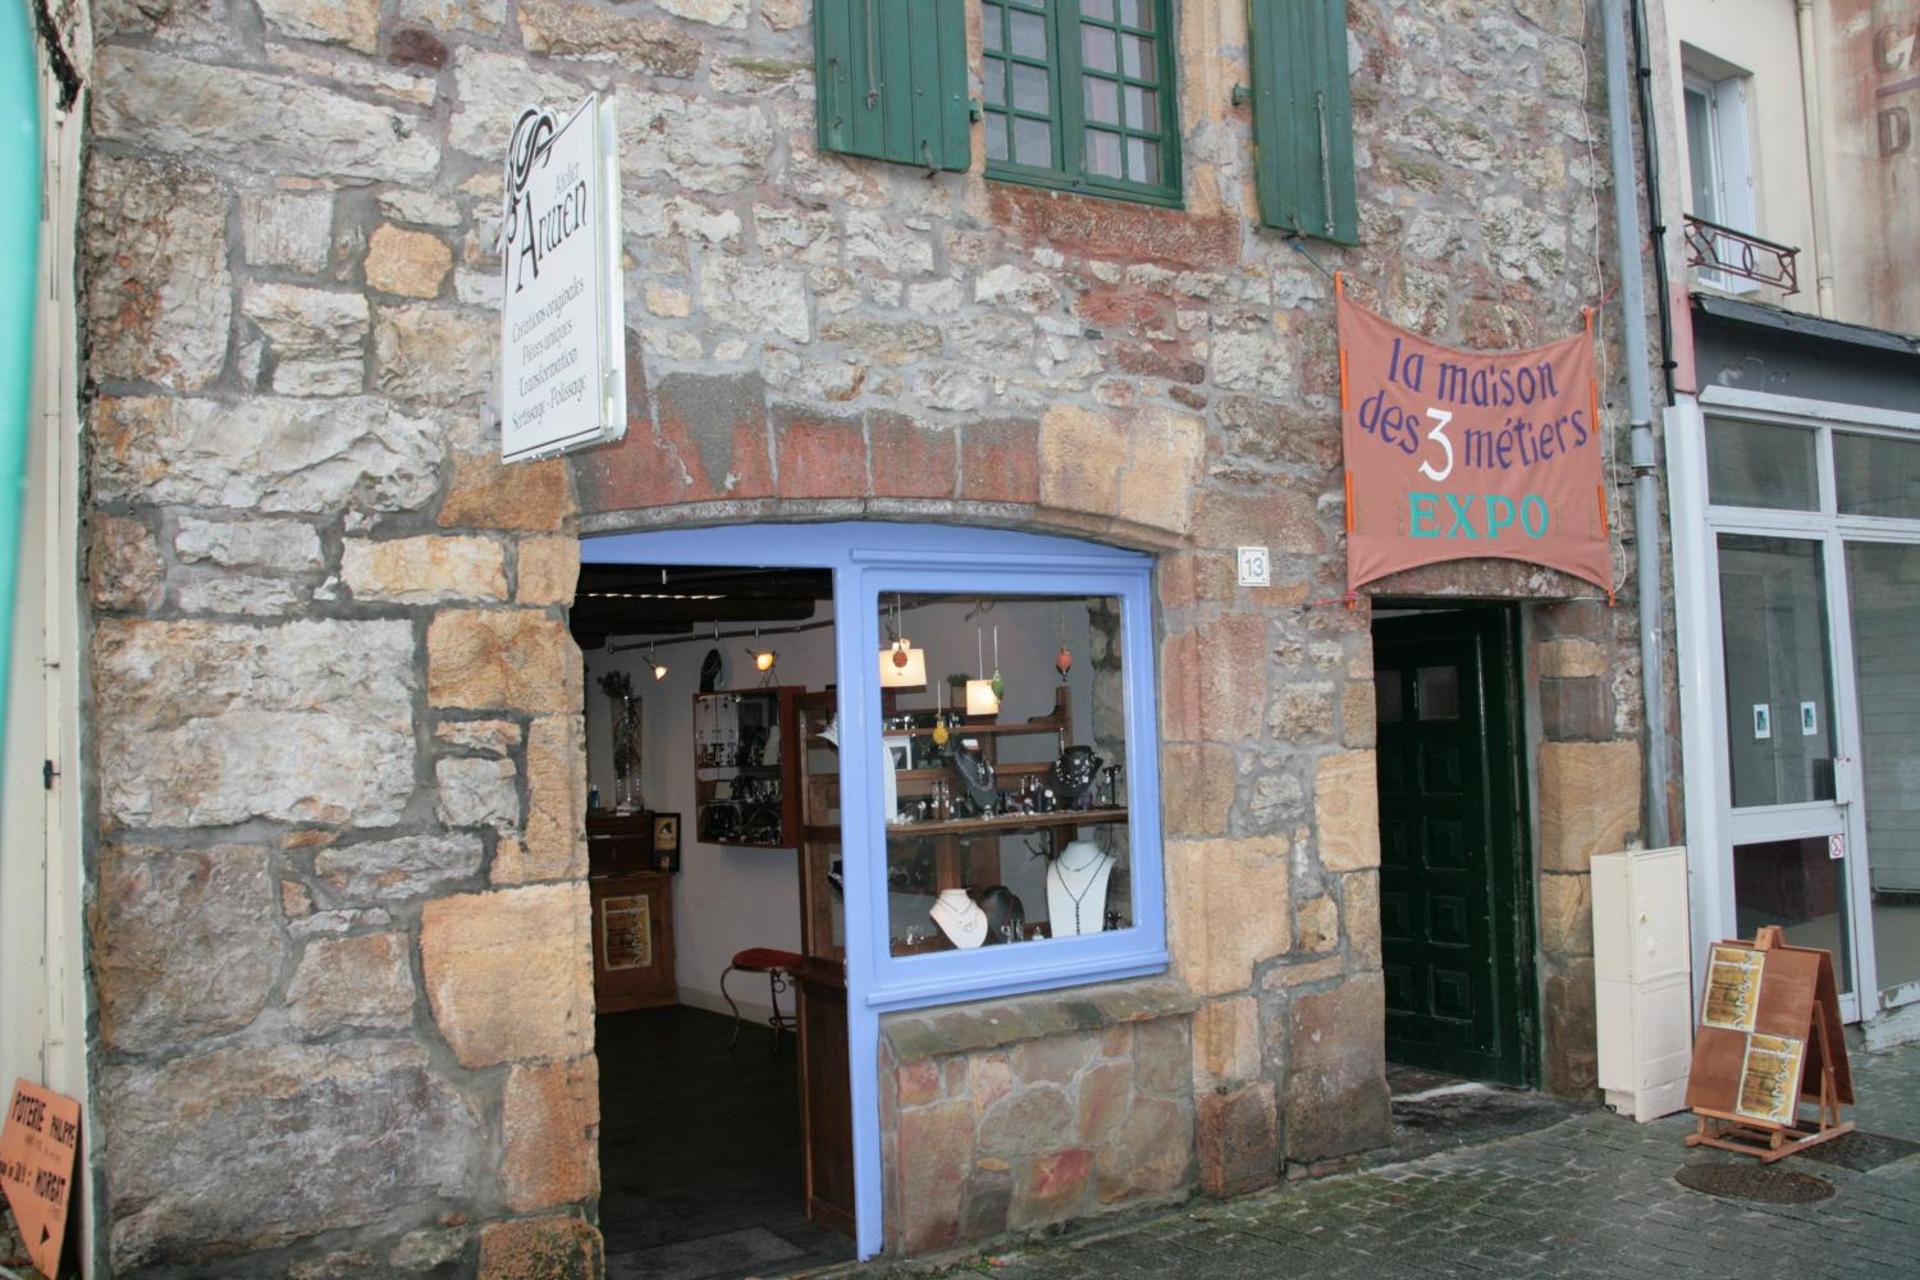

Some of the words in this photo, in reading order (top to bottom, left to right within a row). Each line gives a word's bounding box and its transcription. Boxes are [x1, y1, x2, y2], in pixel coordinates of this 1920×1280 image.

[545, 275, 585, 318] originales
[543, 318, 574, 351] uniques
[518, 346, 578, 398] Transformation
[1388, 338, 1424, 392] la
[1437, 362, 1558, 407] maison
[512, 397, 546, 433] Sertissage
[550, 374, 587, 409] Polissage
[1359, 390, 1419, 454] des
[1418, 407, 1454, 482] 3
[1463, 409, 1588, 470] métiers
[1408, 491, 1549, 540] EXPO
[1245, 557, 1264, 577] 13
